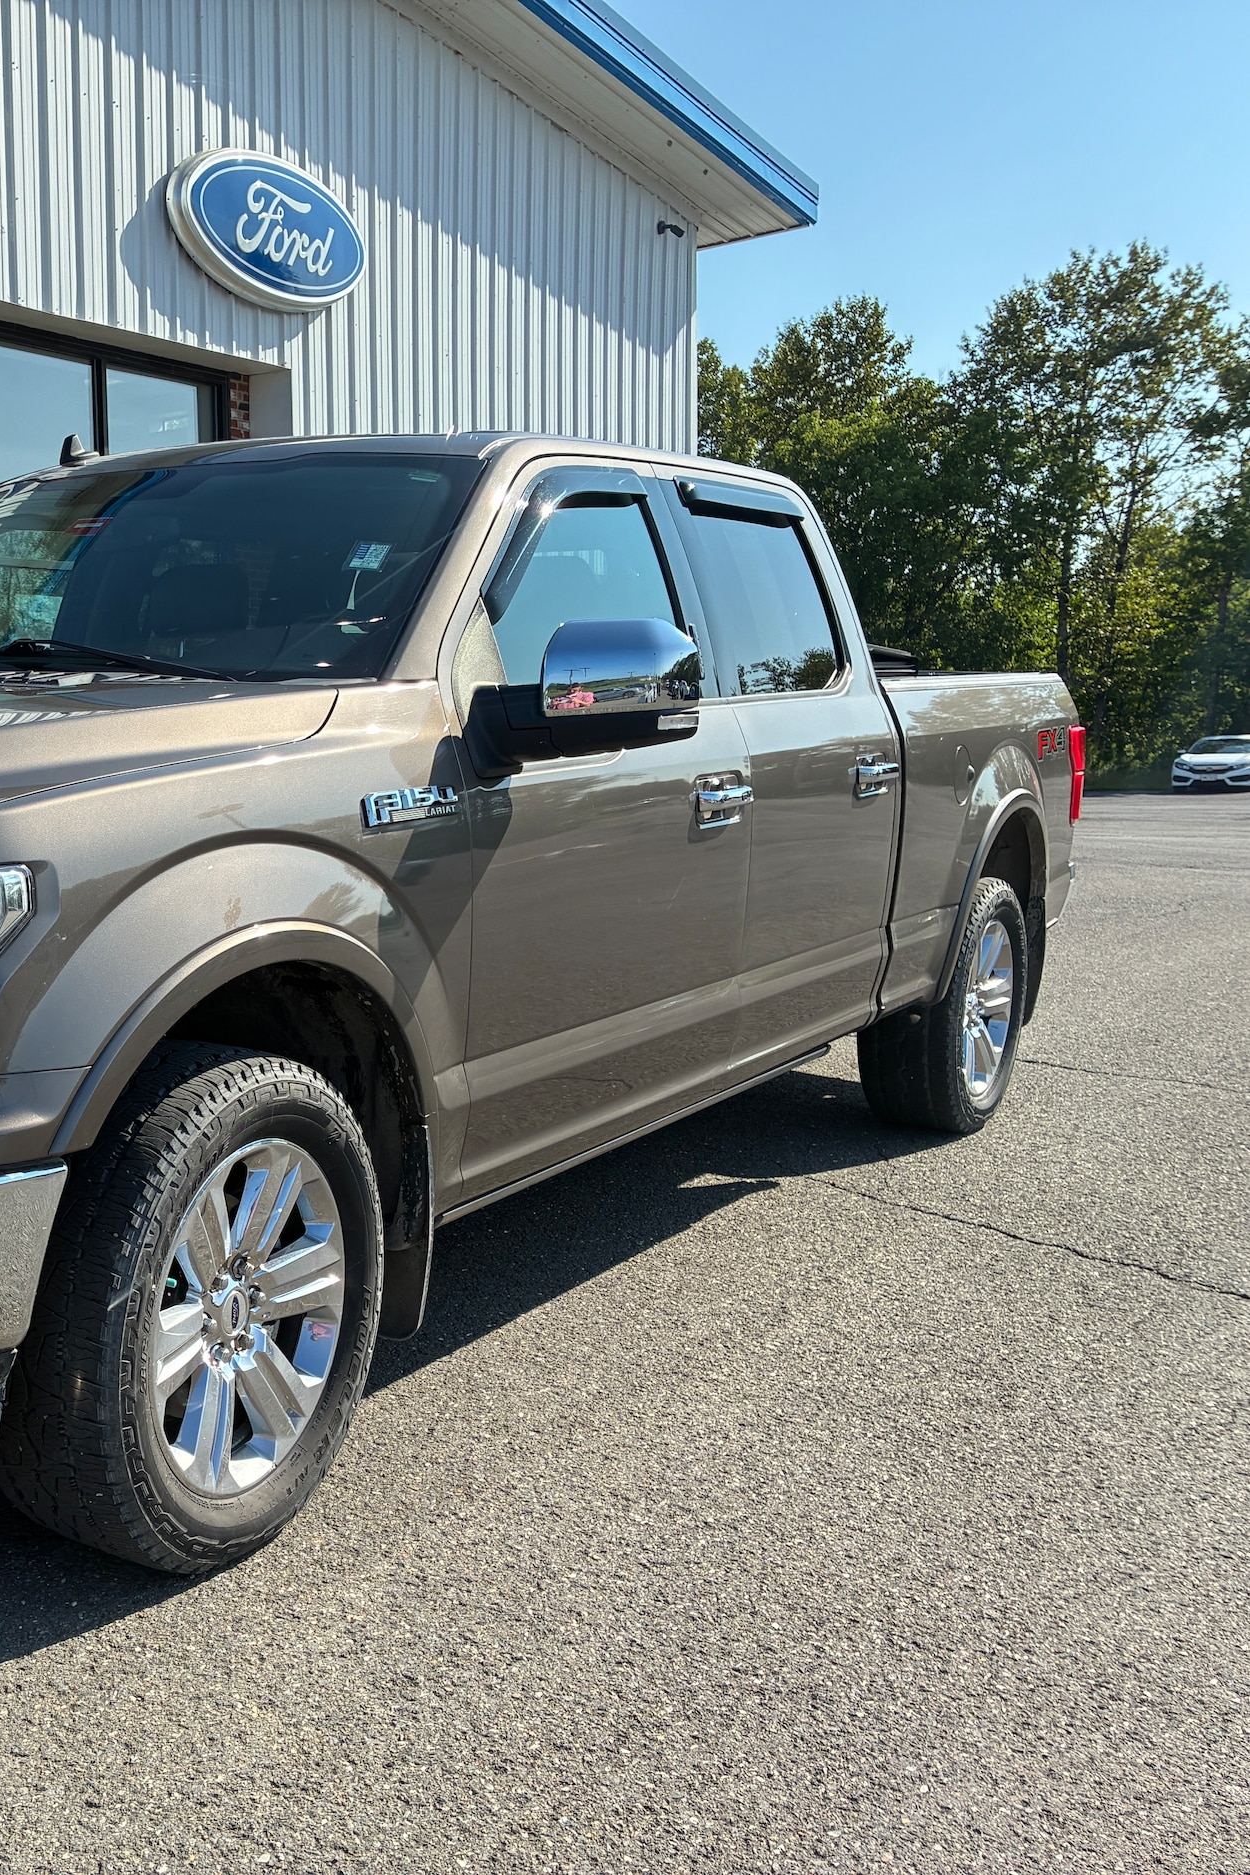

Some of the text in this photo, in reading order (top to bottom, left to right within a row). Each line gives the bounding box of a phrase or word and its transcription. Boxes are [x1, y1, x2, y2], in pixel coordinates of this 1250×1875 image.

[236, 180, 335, 277] Ford
[1037, 726, 1067, 761] FX4
[425, 804, 456, 817] LARIAT
